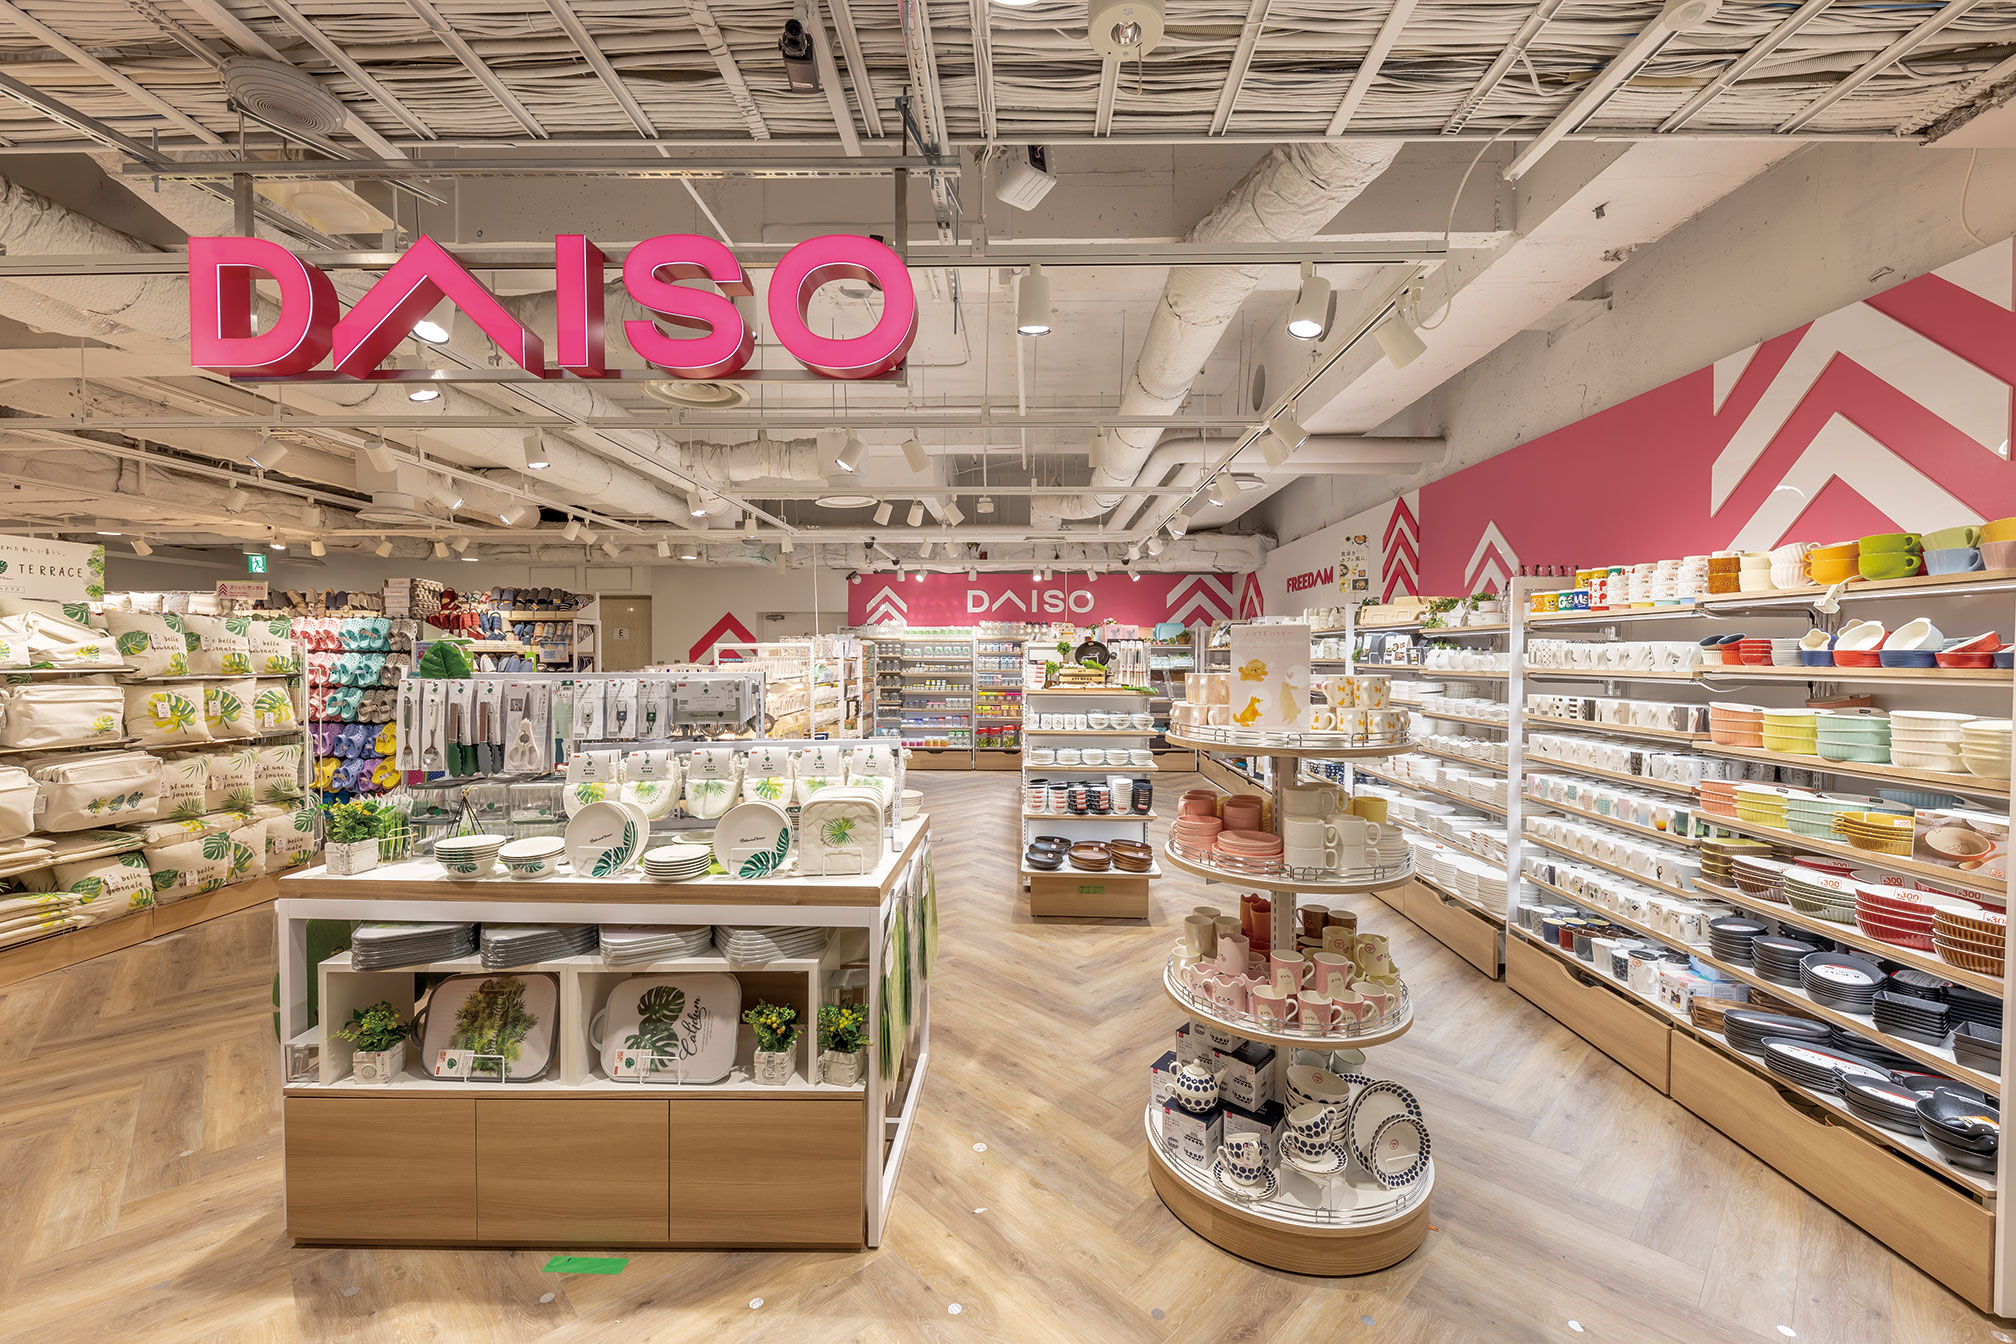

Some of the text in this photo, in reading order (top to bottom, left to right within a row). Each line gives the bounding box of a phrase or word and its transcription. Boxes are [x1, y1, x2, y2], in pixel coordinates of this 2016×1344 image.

[188, 233, 918, 379] DAISO
[19, 563, 83, 578] TERRACE
[1286, 565, 1334, 593] FREEDAM
[966, 588, 1096, 614] DAISO
